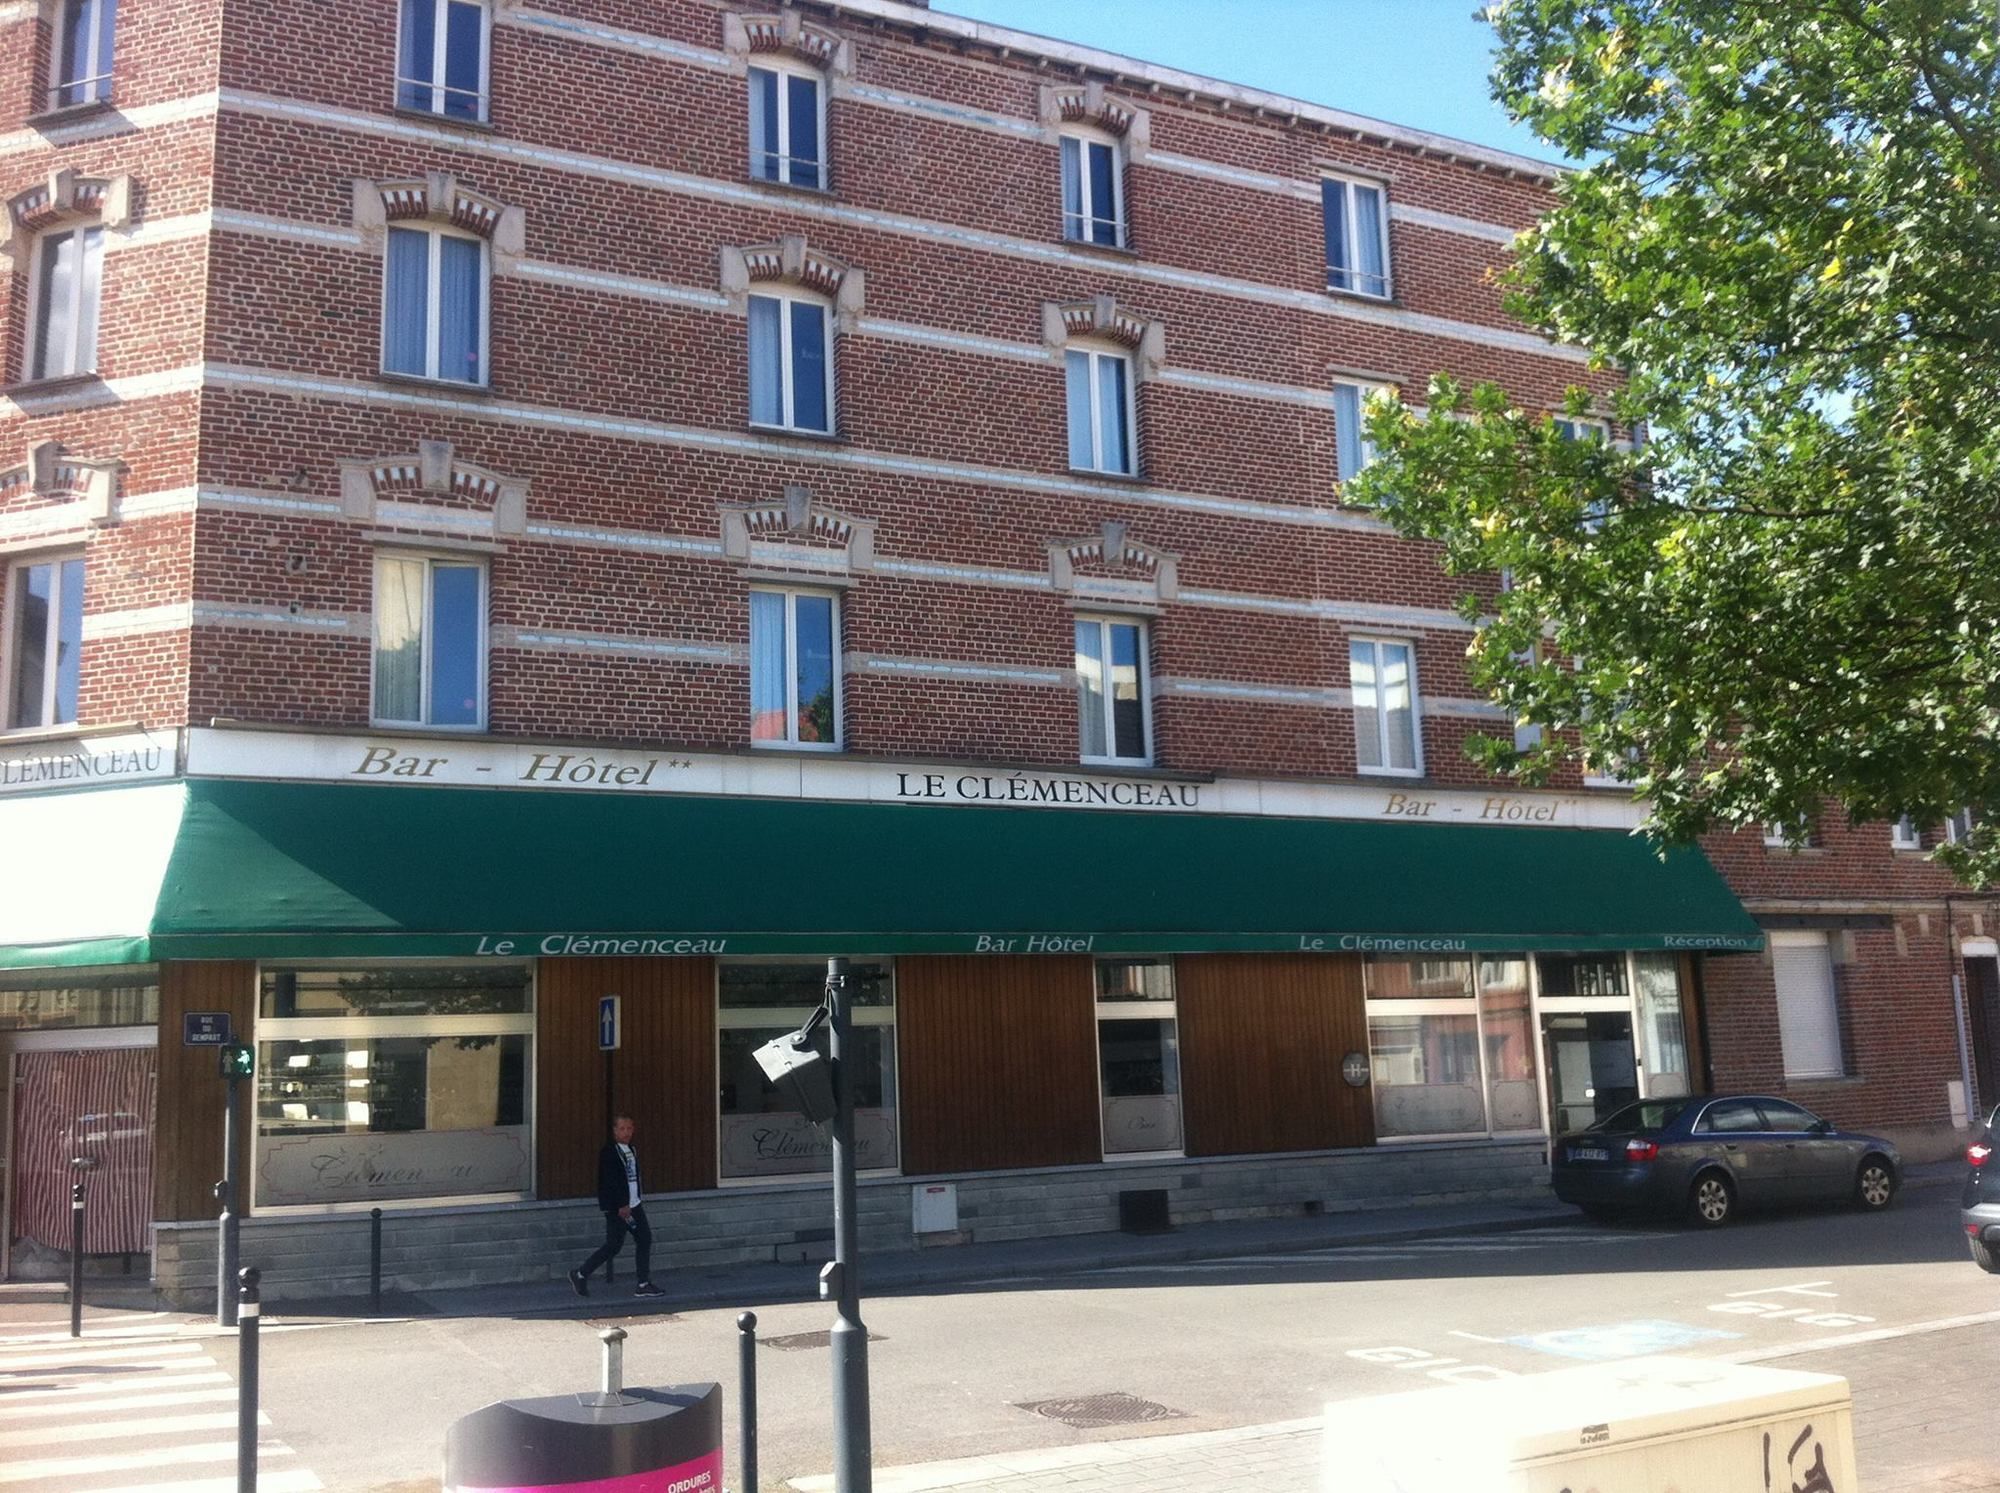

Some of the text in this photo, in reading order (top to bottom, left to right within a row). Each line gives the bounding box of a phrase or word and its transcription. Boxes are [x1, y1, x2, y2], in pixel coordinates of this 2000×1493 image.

[0, 747, 162, 785] LÉMENCEAU
[350, 746, 448, 777] Bar
[896, 771, 1201, 807] LE CLÉMENCEAU
[1381, 793, 1437, 817] Bar
[475, 935, 727, 956] Le Clémenceau
[975, 935, 1094, 952] Bar Hôtel
[1300, 934, 1466, 951] Le Clémenceau
[1663, 935, 1747, 949] Réception
[667, 1470, 711, 1493] ORDURES
